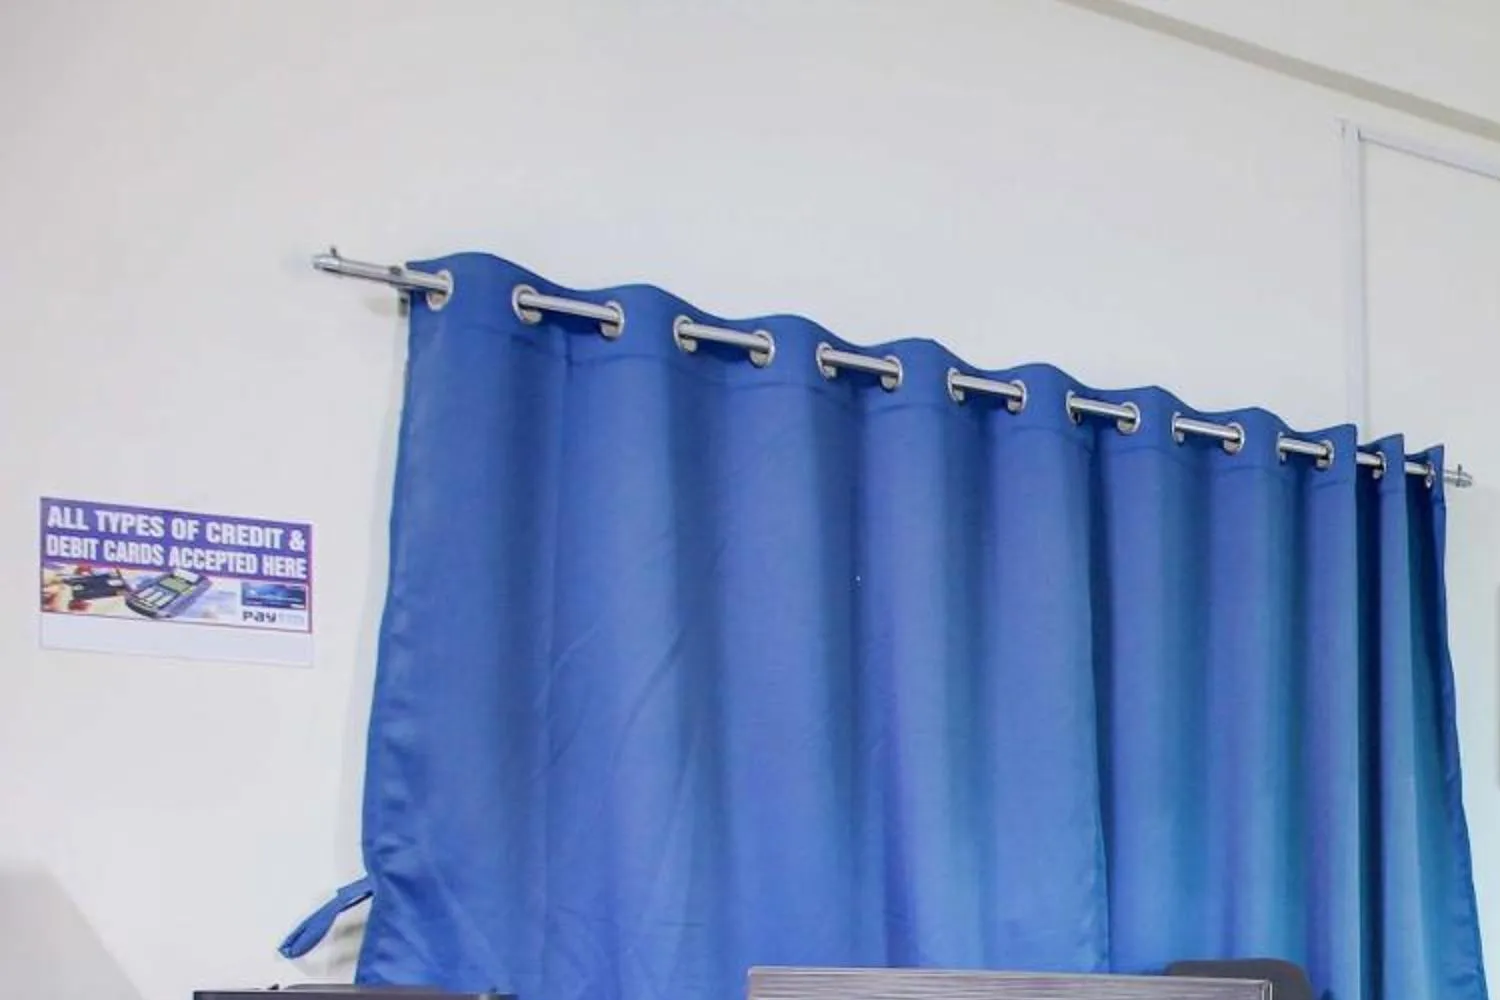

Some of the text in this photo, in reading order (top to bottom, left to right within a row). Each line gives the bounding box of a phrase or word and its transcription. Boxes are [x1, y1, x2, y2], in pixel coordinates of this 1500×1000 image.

[48, 505, 305, 552] ALL TYPES OF CREDIT &
[46, 534, 307, 579] DEBIT CARDS ACCEPTED HERE
